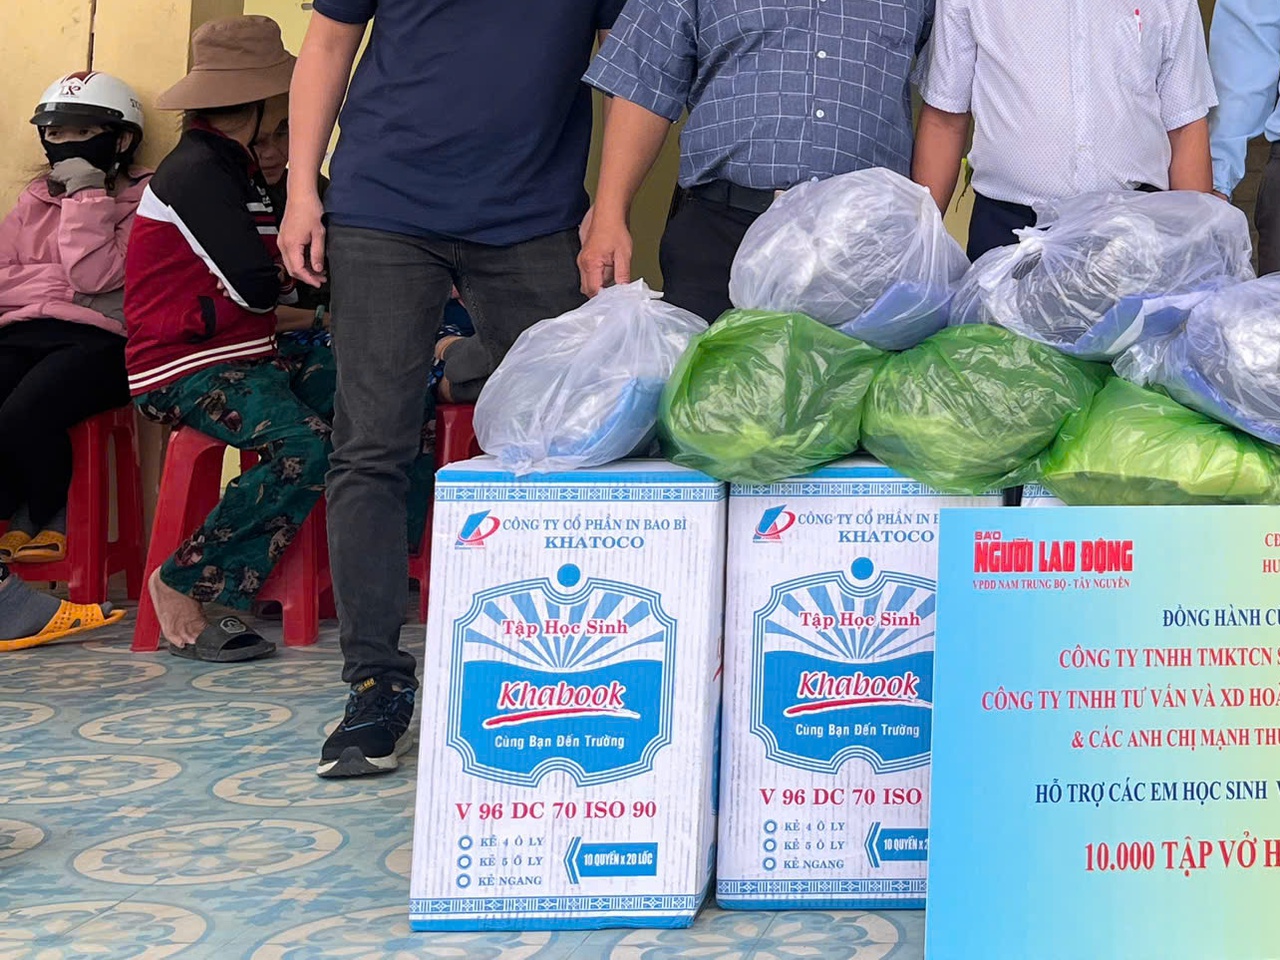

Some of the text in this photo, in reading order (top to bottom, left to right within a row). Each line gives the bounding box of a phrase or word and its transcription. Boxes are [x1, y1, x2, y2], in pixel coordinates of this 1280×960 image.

[503, 513, 687, 531] CÔNG TY CỔ PHẦN IN BAO BÌ
[798, 508, 912, 525] CÔNG TY PHẦN
[544, 535, 644, 549] KHATOCO
[838, 529, 935, 543] KHATOCO
[974, 537, 1134, 574] NGƯỜI LAO ĐỘNG
[998, 579, 1019, 590] NAM
[1021, 578, 1052, 590] TRUNG
[1053, 578, 1068, 591] BỘ
[1073, 576, 1092, 589] TÂY
[1093, 575, 1130, 589] NGUYÊN
[800, 612, 921, 630] Tập Học Sinh
[1163, 604, 1209, 627] ĐỒNG
[1215, 603, 1261, 627] HÀNH
[502, 619, 628, 638] Tập Học Sinh
[1059, 644, 1110, 668] CÔNG
[1115, 649, 1138, 667] TY
[1143, 648, 1192, 667] TNHH
[1197, 647, 1272, 667] TMKTCN
[799, 672, 919, 697] Khabook
[499, 682, 625, 708] Khabook
[981, 686, 1033, 710] CÔNG
[1038, 691, 1062, 710] TY
[1066, 690, 1117, 709] TNHH
[1121, 686, 1147, 709] TƯ
[1151, 683, 1186, 708] VẤN
[1192, 683, 1216, 708] VÀ
[1220, 688, 1245, 707] XD
[494, 733, 625, 750] Cùng Bạn Đến Trường
[1071, 730, 1085, 748] &
[1089, 725, 1123, 748] CÁC
[1128, 729, 1162, 747] ANH
[1167, 729, 1197, 751] CHỊ
[1200, 728, 1250, 751] MẠNH
[1035, 778, 1063, 803] HỖ
[1067, 782, 1106, 808] TRỢ
[1109, 777, 1146, 802] CÁC
[1151, 782, 1178, 802] EM
[1182, 781, 1221, 806] HỌC
[1226, 780, 1268, 800] SINH
[455, 801, 657, 820] V 96 DC 70 ISO 90
[503, 837, 508, 847] 4
[529, 837, 545, 847] LY
[502, 856, 508, 867] 5
[527, 856, 544, 867] LY
[584, 853, 593, 866] 10
[594, 850, 619, 866] QUYỂN
[626, 853, 637, 865] 20
[637, 849, 653, 866] LỐC
[1085, 842, 1155, 871] 10.000
[1161, 836, 1214, 878] TẬP
[1218, 831, 1257, 869] VỞ
[498, 875, 542, 887] NGANG
